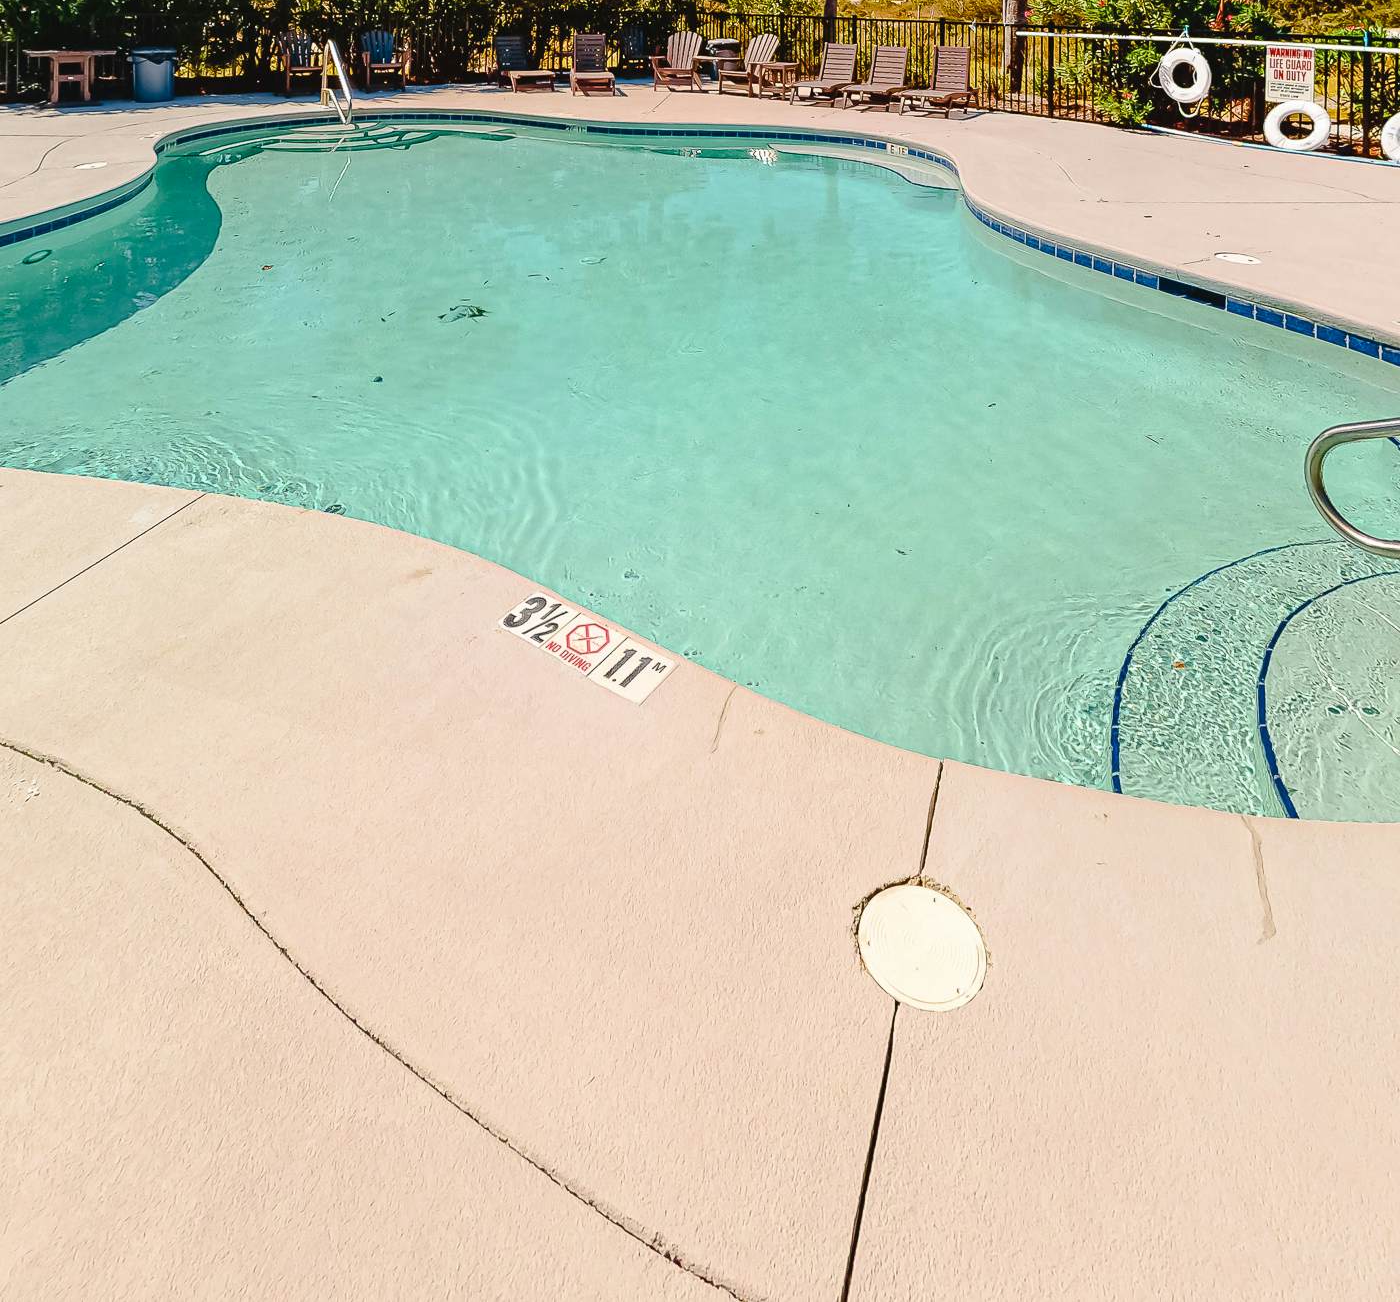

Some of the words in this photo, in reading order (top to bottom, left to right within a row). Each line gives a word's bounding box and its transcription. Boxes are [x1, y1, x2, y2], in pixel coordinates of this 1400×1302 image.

[1269, 58, 1284, 69] LIFE
[1286, 60, 1312, 71] GUARD
[1273, 69, 1284, 80] ON
[1286, 71, 1307, 82] DUTY
[545, 640, 562, 655] NO
[559, 649, 592, 672] DIVING
[603, 648, 653, 688] 1.1
[651, 661, 667, 674] M
